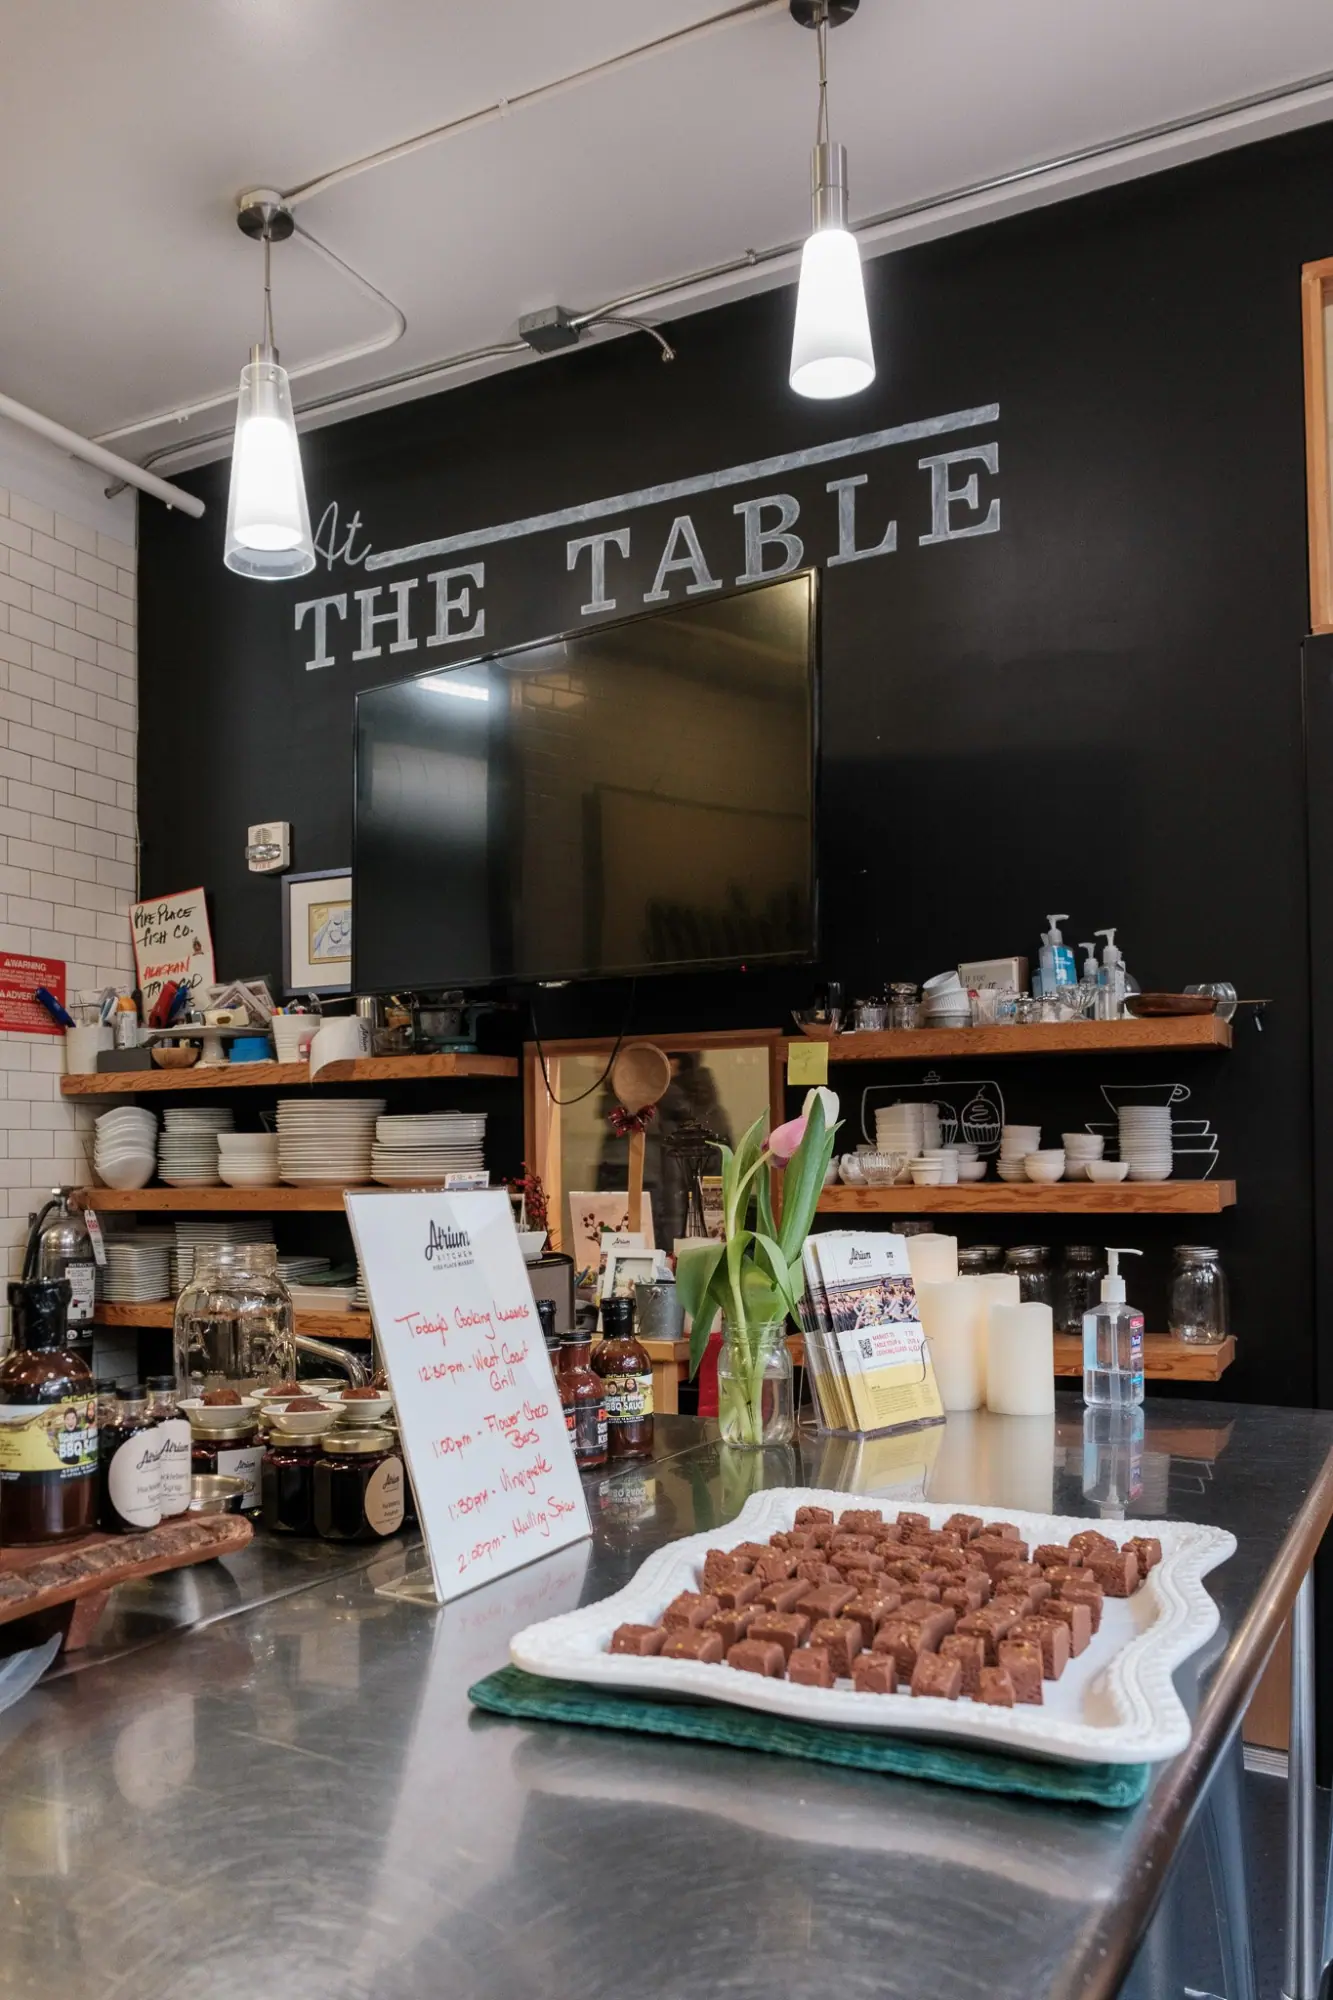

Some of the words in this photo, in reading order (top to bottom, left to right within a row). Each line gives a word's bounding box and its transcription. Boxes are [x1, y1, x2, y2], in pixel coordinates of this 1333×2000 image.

[314, 501, 372, 572] At
[294, 561, 486, 671] THE
[566, 441, 1001, 615] TABLE
[134, 905, 156, 929] PIKE
[157, 903, 197, 925] PLACE
[11, 959, 47, 972] WARNING
[143, 955, 190, 980] ALASKAN
[425, 1219, 470, 1261] Atrium
[394, 1311, 449, 1347] Today's
[454, 1305, 496, 1340] Cooking
[418, 1361, 465, 1385] 12:30pm
[472, 1343, 500, 1372] West
[501, 1339, 529, 1365] Coast
[489, 1367, 517, 1392] Grill
[623, 1399, 645, 1411] SAUCE
[431, 1433, 472, 1460] 1:00pm
[483, 1411, 521, 1432] Flower
[522, 1399, 549, 1421] Choco
[504, 1427, 540, 1449] Bars
[447, 1488, 488, 1521] 1:30pm
[457, 1534, 501, 1574] 2:00pm
[511, 1508, 551, 1538] Mulling
